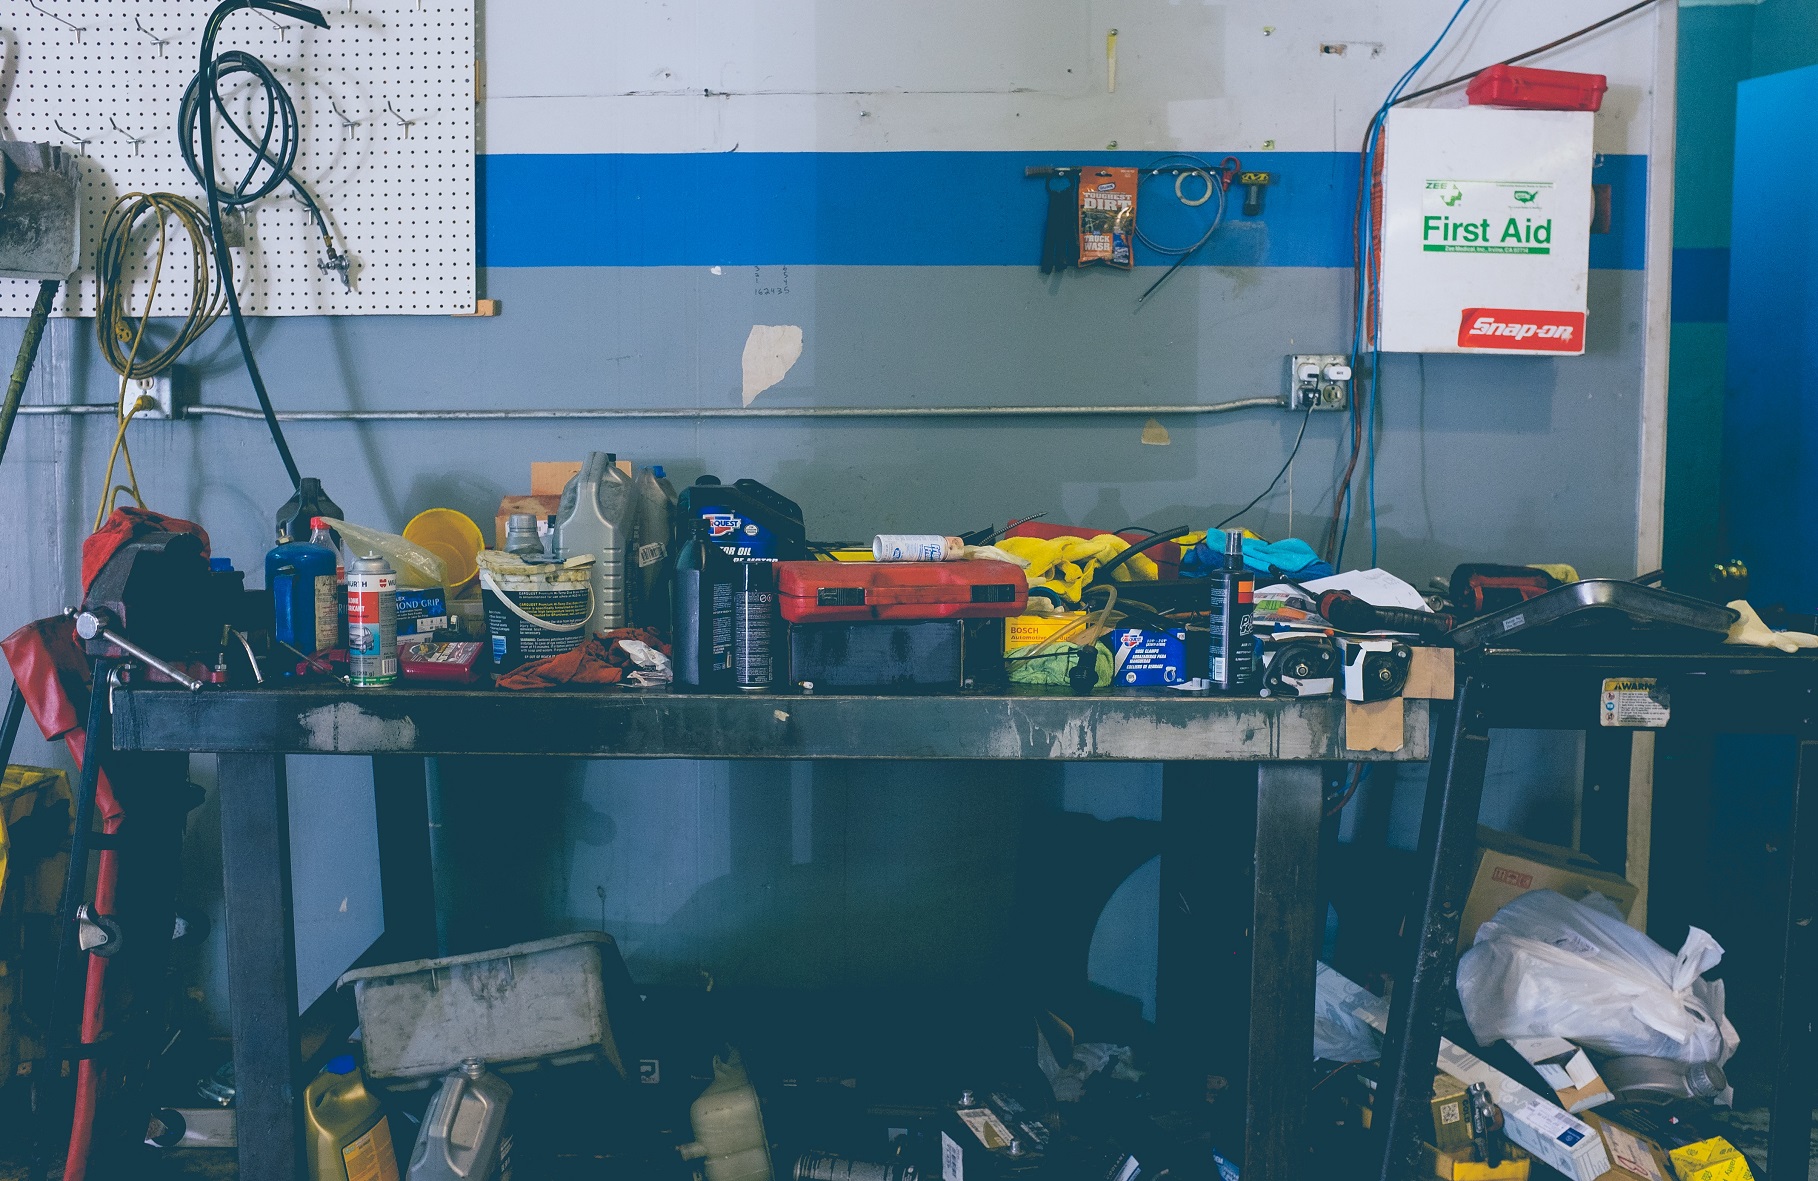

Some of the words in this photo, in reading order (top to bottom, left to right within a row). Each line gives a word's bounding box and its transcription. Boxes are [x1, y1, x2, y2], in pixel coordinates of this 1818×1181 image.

[1084, 192, 1132, 200] TOUGHEST
[1084, 198, 1132, 211] DIRT
[1423, 215, 1490, 242] First
[1500, 217, 1552, 244] Aid
[1084, 242, 1110, 251] WASH
[1469, 317, 1573, 341] Snap-on
[737, 547, 752, 556] OIL
[420, 598, 440, 608] GRIP
